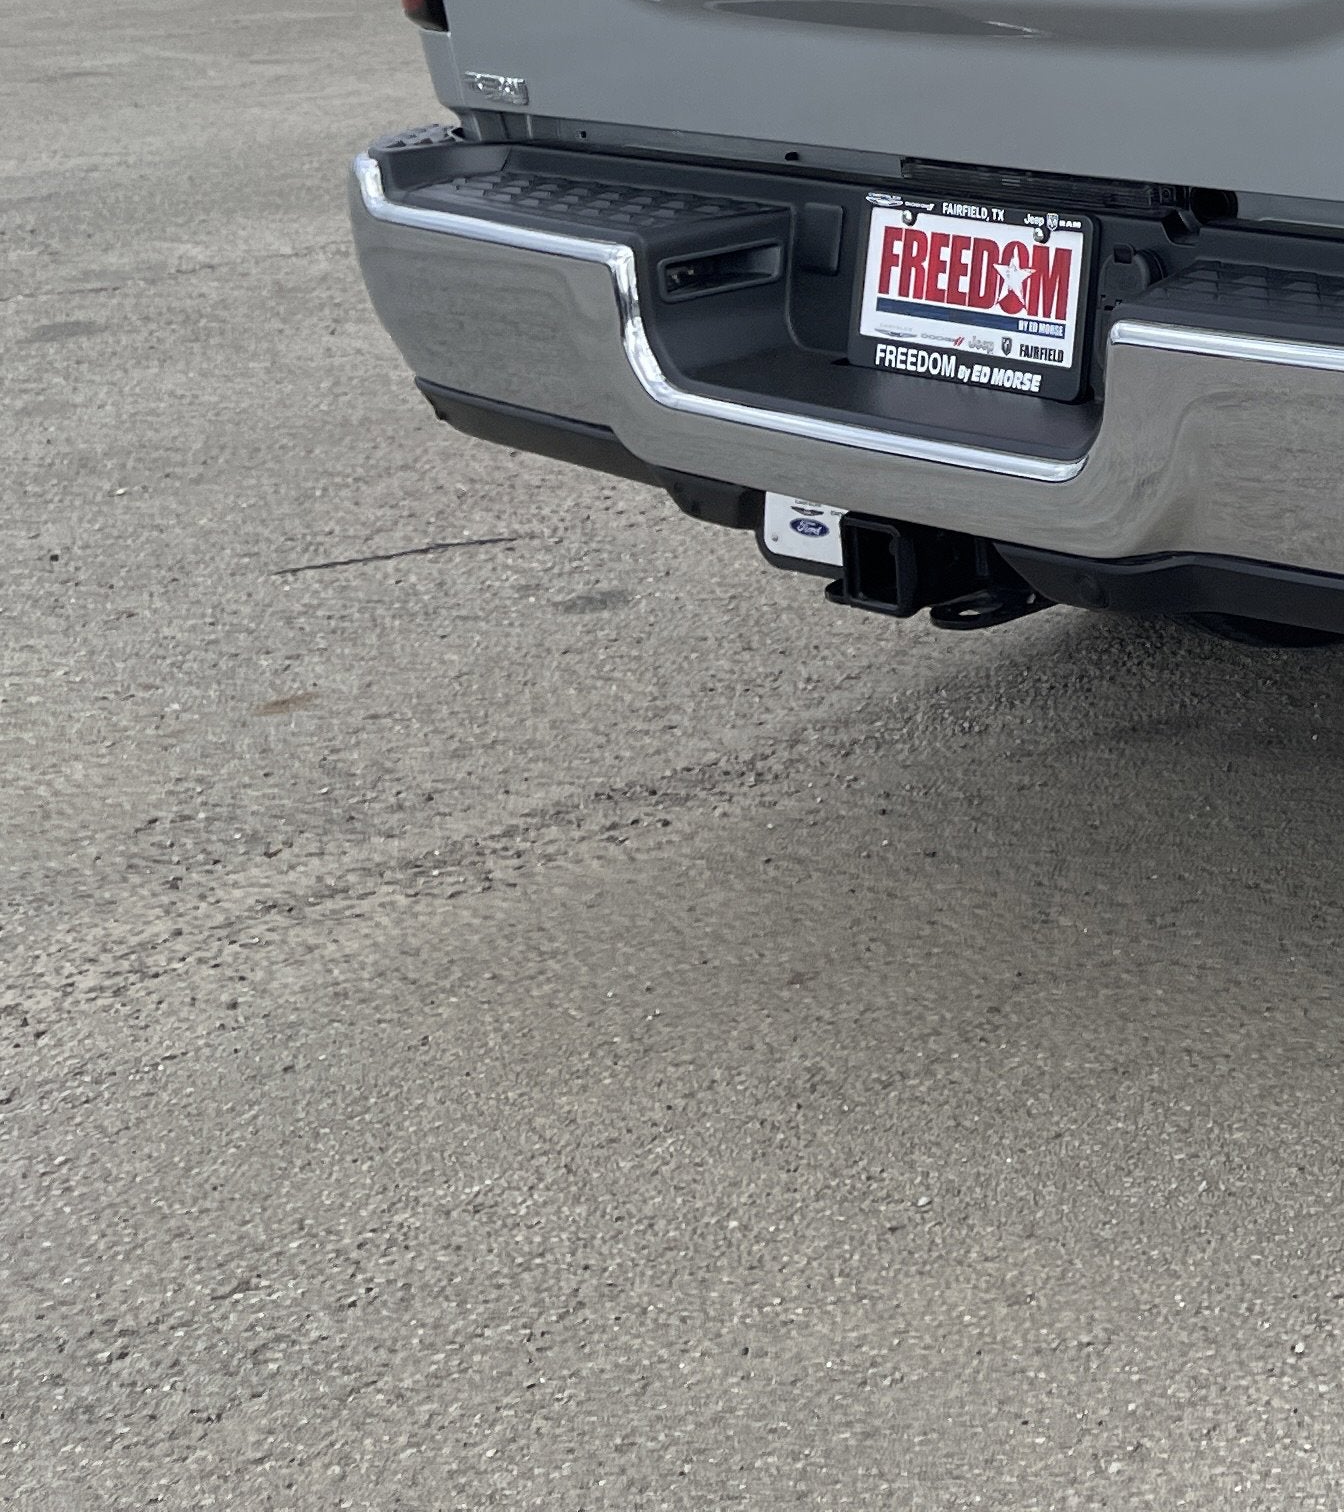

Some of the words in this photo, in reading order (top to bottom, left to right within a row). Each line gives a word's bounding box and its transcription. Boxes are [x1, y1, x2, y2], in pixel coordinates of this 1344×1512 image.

[942, 202, 990, 221] FAIRFIELD,
[991, 208, 1005, 222] TX
[877, 225, 1073, 321] FREEDOM
[875, 343, 957, 378] FREEDOM
[971, 364, 991, 384] ED
[990, 367, 1042, 392] MORSE
[1020, 344, 1065, 363] FAIRFIELD
